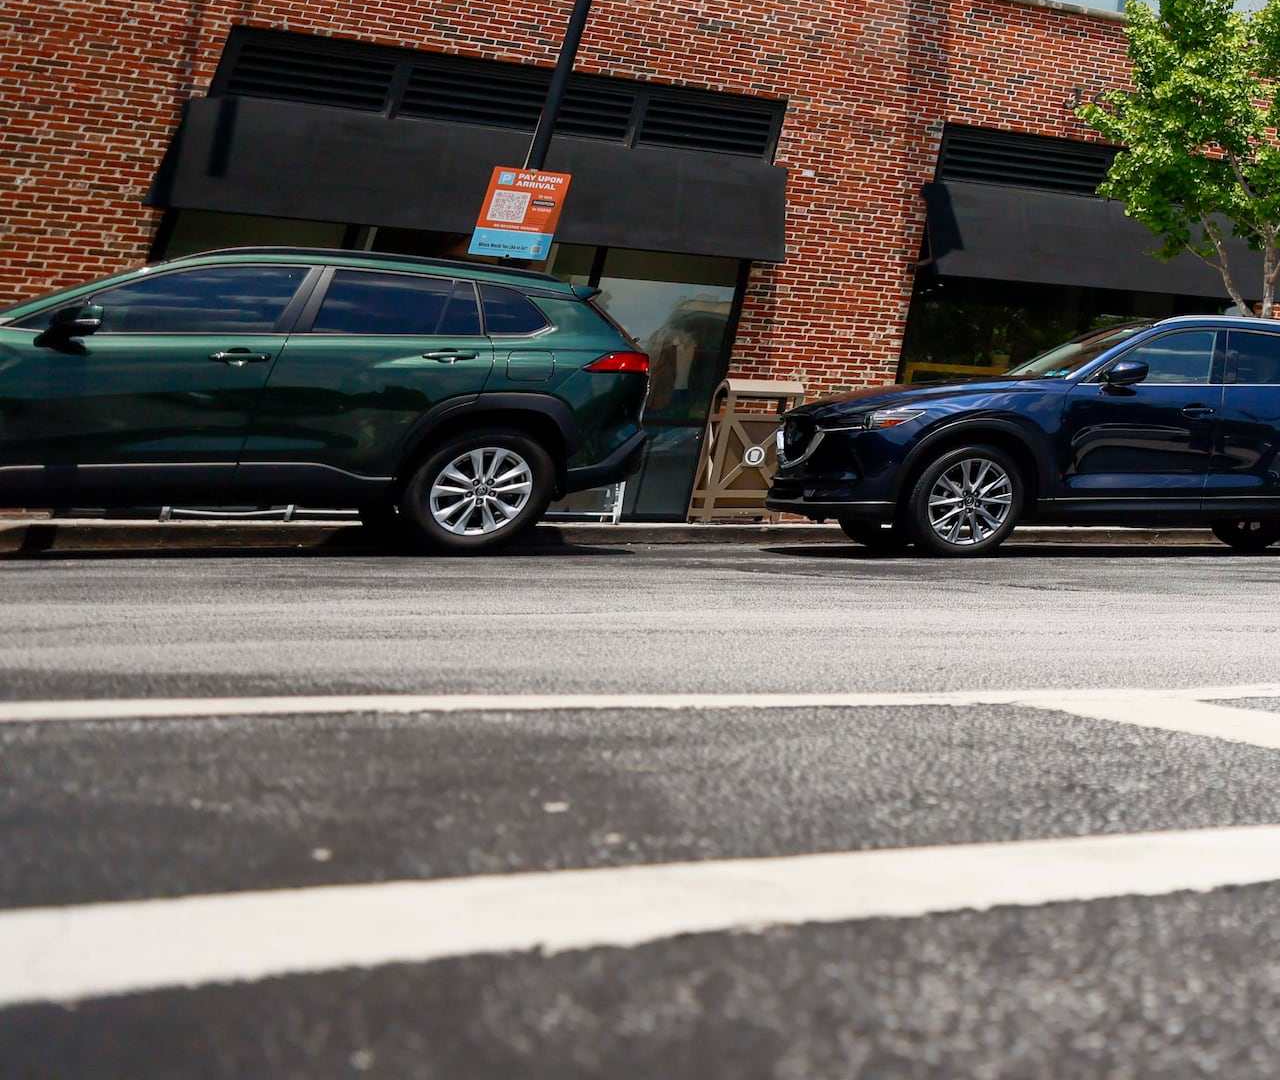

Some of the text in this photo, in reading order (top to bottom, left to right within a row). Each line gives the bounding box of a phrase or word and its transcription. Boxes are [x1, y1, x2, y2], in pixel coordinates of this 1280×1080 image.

[518, 173, 564, 184] PAY UPON
[516, 181, 556, 190] ARRIVAL
